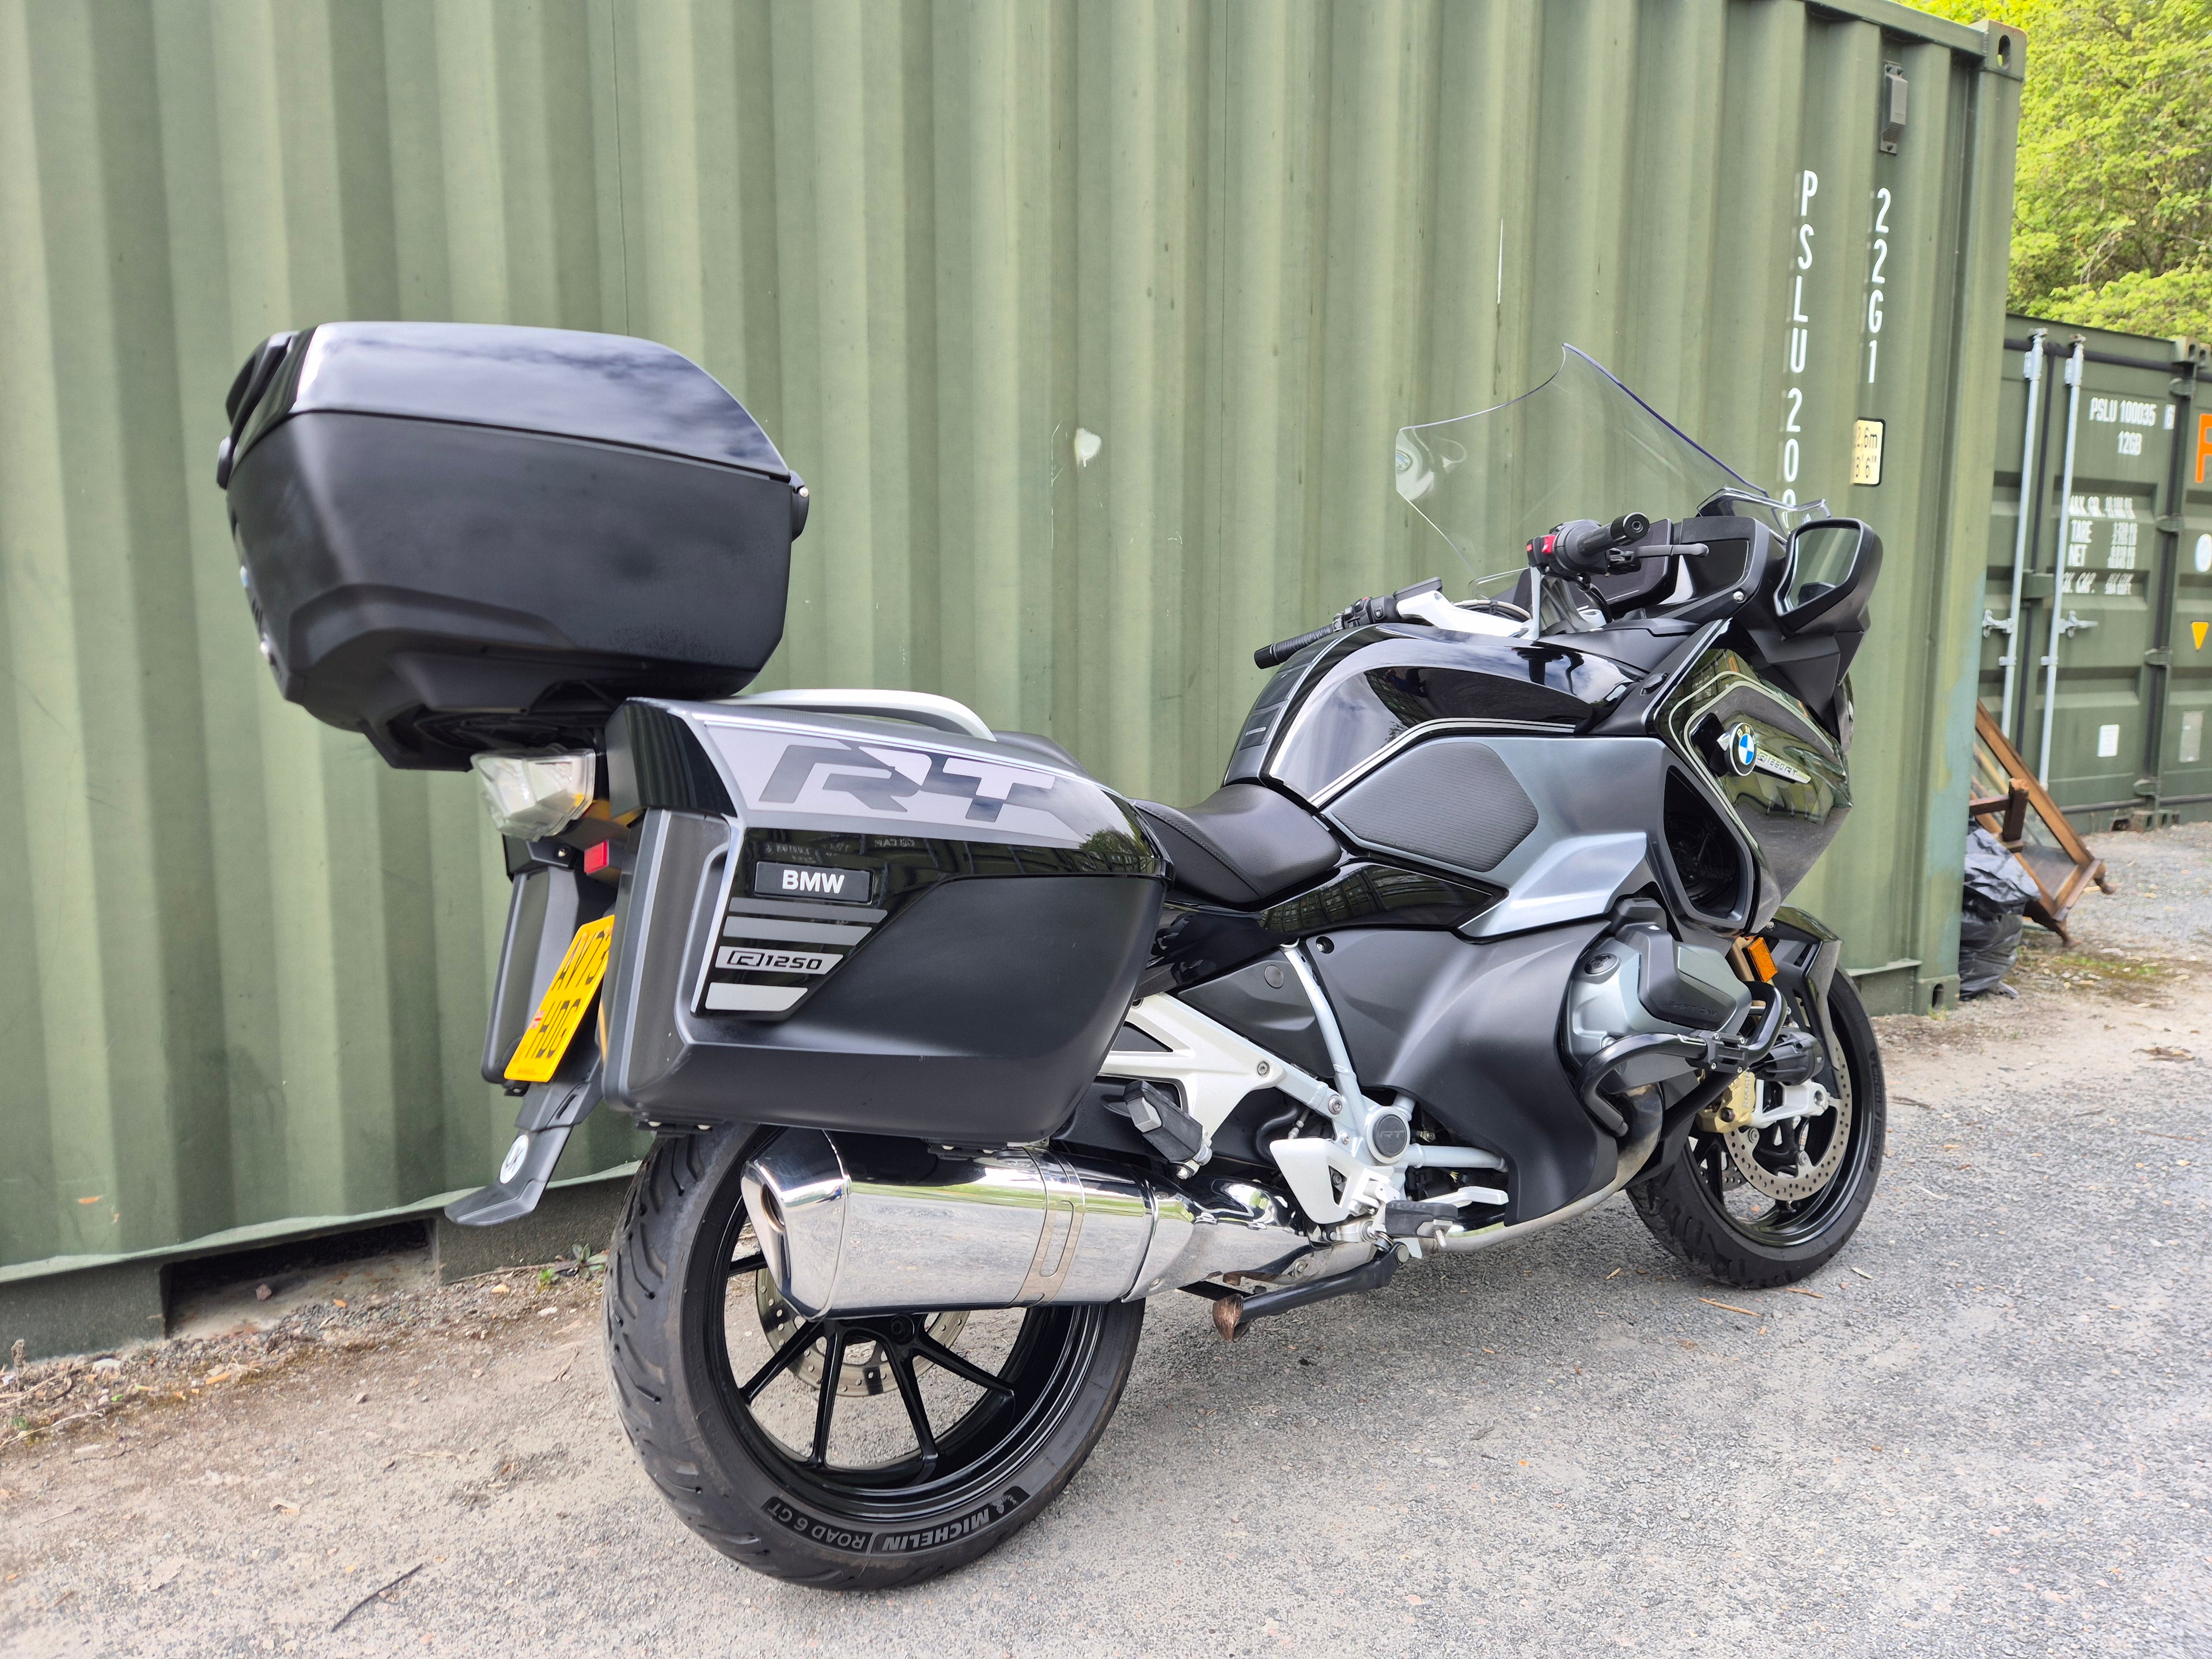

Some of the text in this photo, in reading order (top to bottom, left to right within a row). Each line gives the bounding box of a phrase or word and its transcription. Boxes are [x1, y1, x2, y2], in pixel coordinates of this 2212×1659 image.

[1789, 170, 1818, 373] PSLU
[1868, 187, 1891, 384] 22G1
[2089, 397, 2118, 422] PSLU
[2119, 400, 2157, 426] 100035
[2071, 519, 2093, 543] TARE
[2068, 543, 2088, 567] NET
[759, 744, 1055, 823] RT
[782, 869, 845, 894] BMW
[1668, 1000, 1718, 1017] SHIFT CAM
[525, 998, 582, 1059] HDG
[1378, 1130, 1405, 1138] RT
[767, 1502, 990, 1551] MICHELIN ROAD 6 GT
